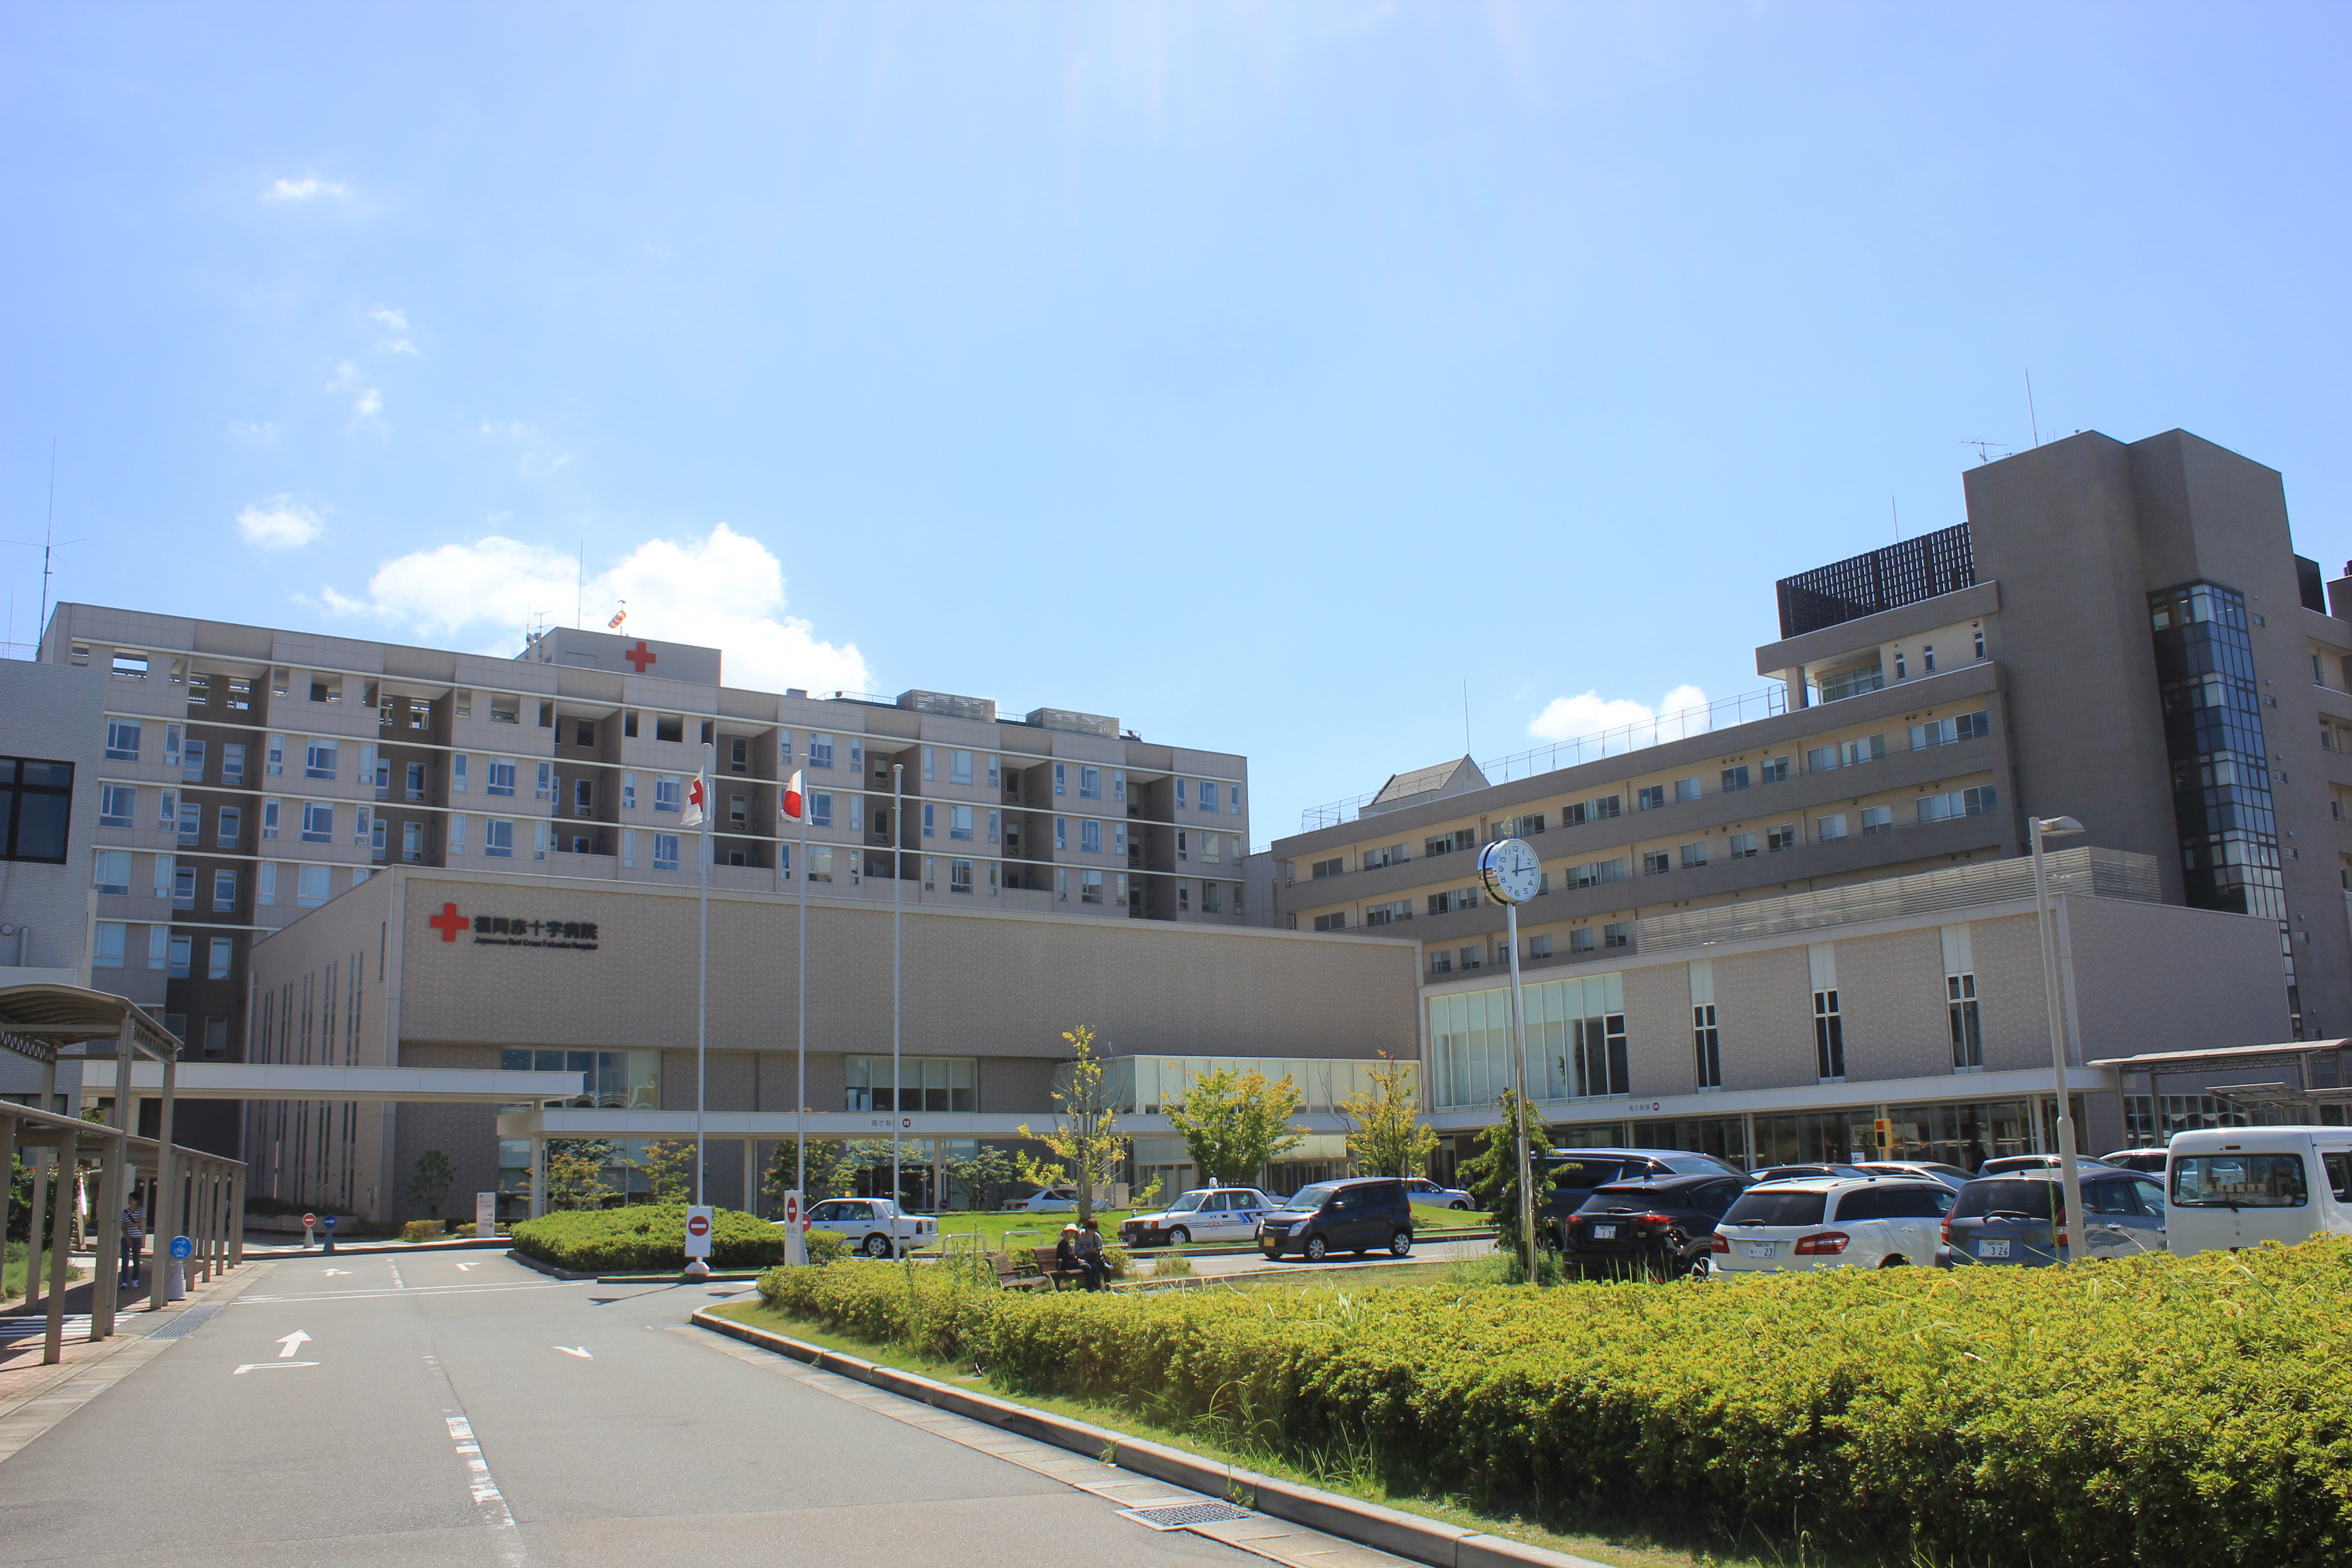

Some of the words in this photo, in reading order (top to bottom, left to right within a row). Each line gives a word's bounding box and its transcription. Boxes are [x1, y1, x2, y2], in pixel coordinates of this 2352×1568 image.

[474, 915, 598, 940] 福岡赤十字病院
[474, 936, 508, 945] Japanese
[508, 938, 522, 946] Red
[523, 939, 542, 947] Cross
[542, 940, 571, 949] Fukuoka
[572, 942, 598, 951] Hospital
